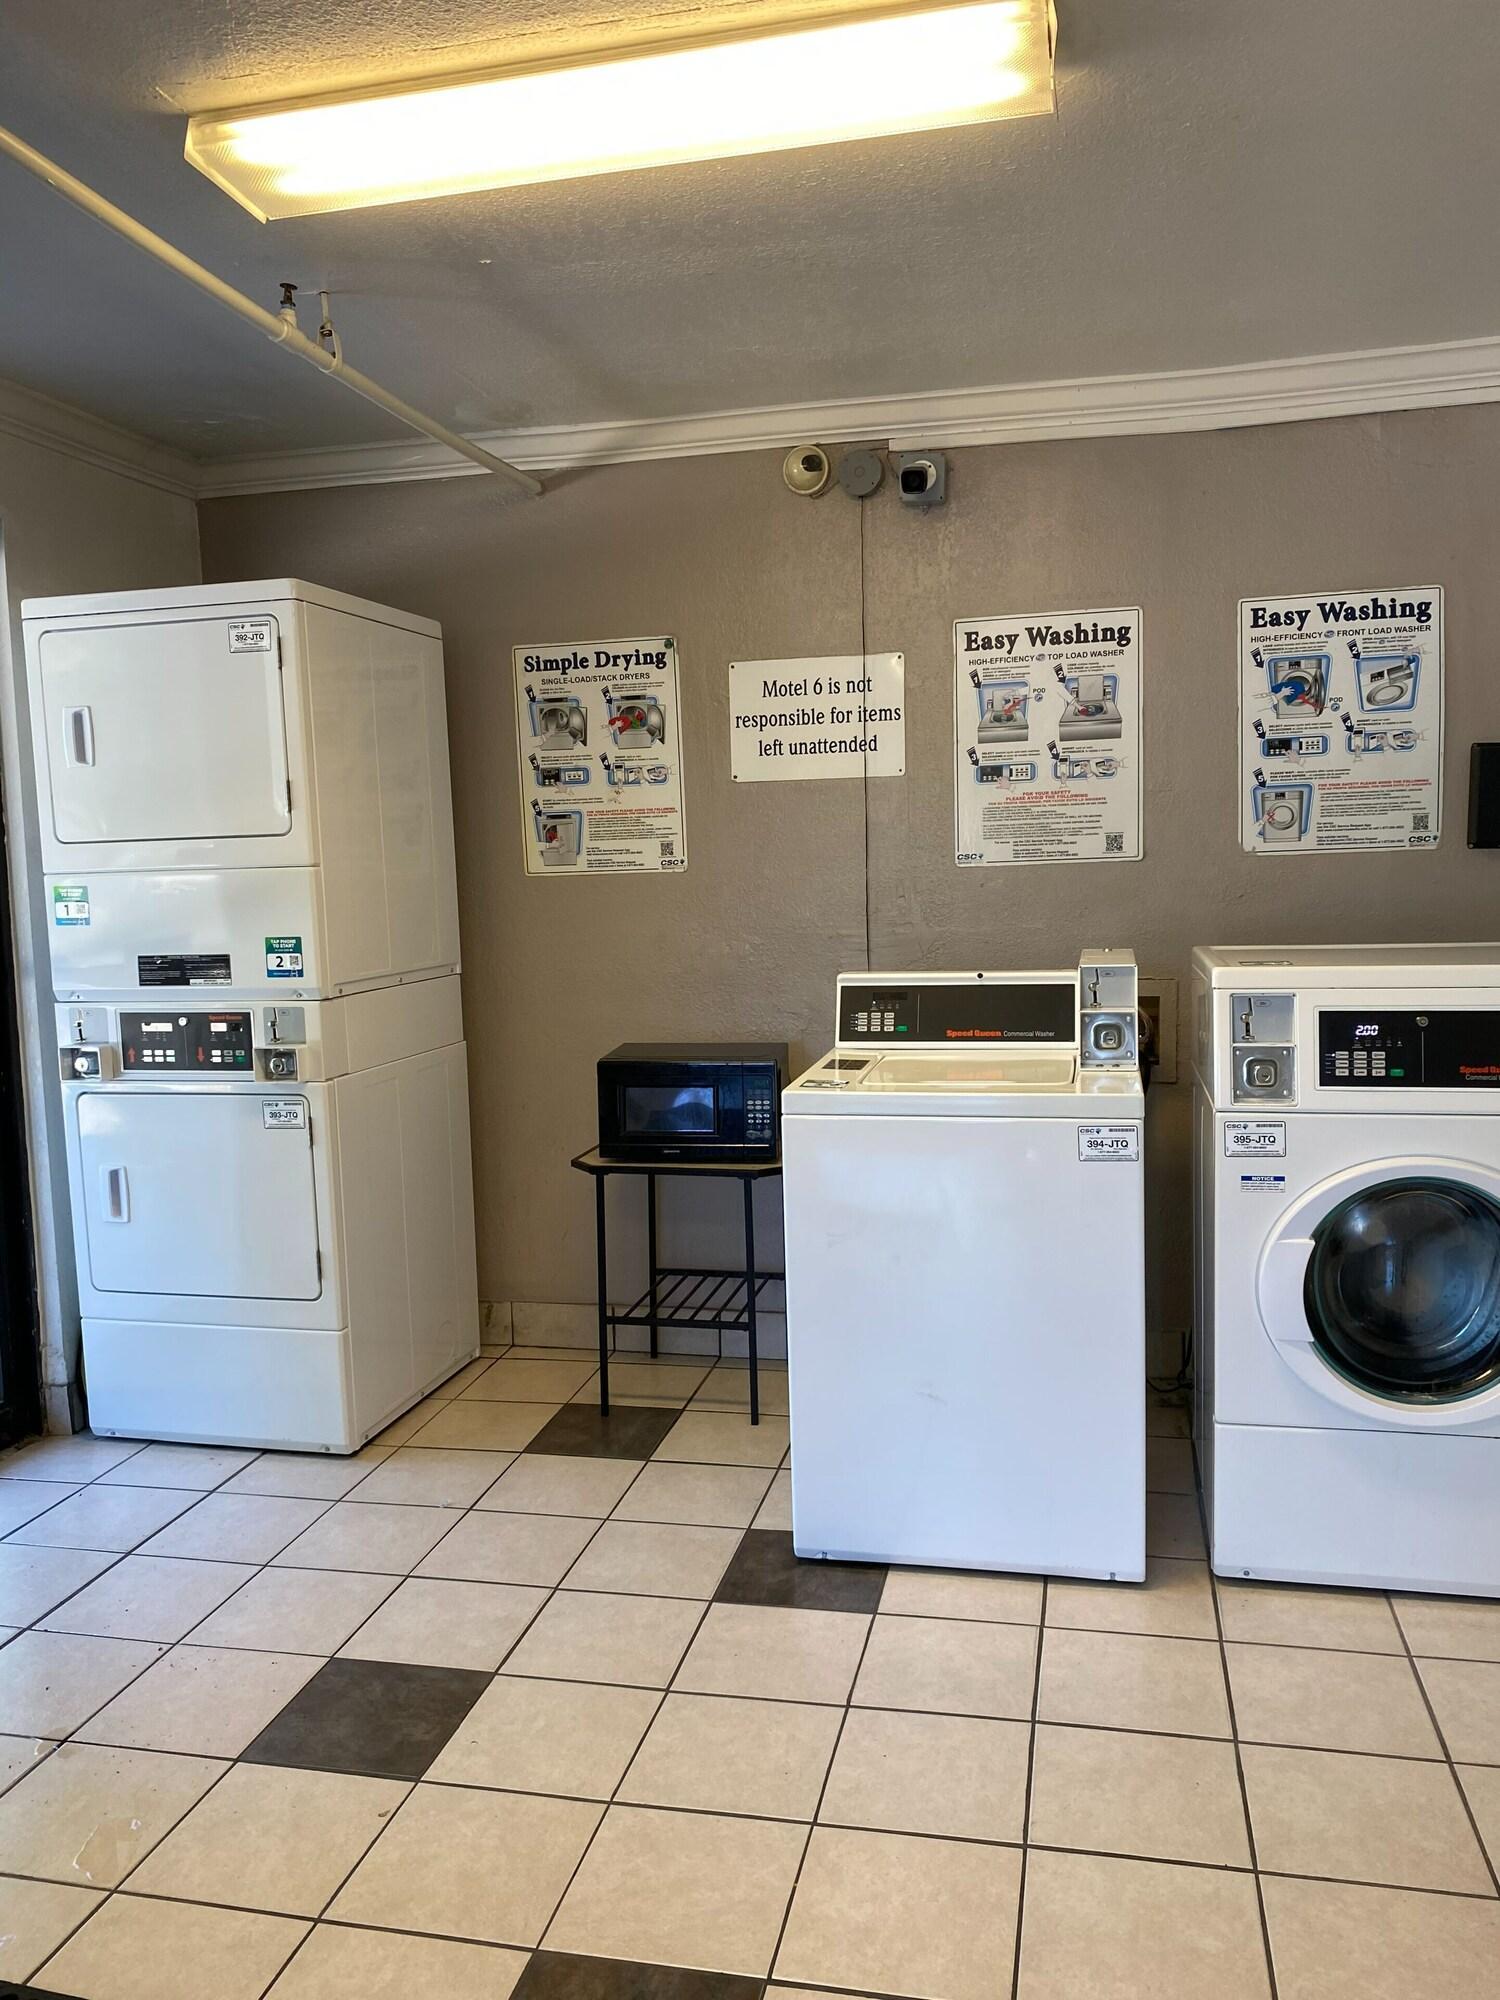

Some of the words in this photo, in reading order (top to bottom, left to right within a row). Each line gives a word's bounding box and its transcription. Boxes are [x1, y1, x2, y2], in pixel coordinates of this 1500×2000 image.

[1251, 608, 1311, 631] Easy
[1317, 598, 1432, 623] Washing
[235, 633, 264, 641] 392-JTQ
[964, 632, 1019, 654] Easy
[1025, 623, 1131, 647] Washing
[1251, 632, 1322, 643] HIGH-EFFICIENCY
[1368, 627, 1392, 635] LOAD
[1394, 625, 1431, 634] WASHER
[524, 652, 589, 675] Simple
[595, 649, 667, 671] Drying
[969, 655, 1035, 666] HIGH-EFFICIENCY
[1090, 649, 1124, 658] WASHER
[541, 674, 617, 685] SINGLE-LOAD/STACK
[620, 672, 650, 681] DRYERS
[762, 679, 808, 697] Motel
[813, 678, 823, 695] 6
[828, 677, 840, 694] is
[846, 676, 872, 693] not
[735, 708, 824, 731] responsible
[830, 707, 852, 724] for
[858, 706, 901, 722] items
[759, 739, 784, 756] left
[789, 734, 878, 755] unattended
[64, 905, 69, 916] 1
[276, 956, 284, 967] 2
[1087, 1140, 1128, 1148] 394-JTQ
